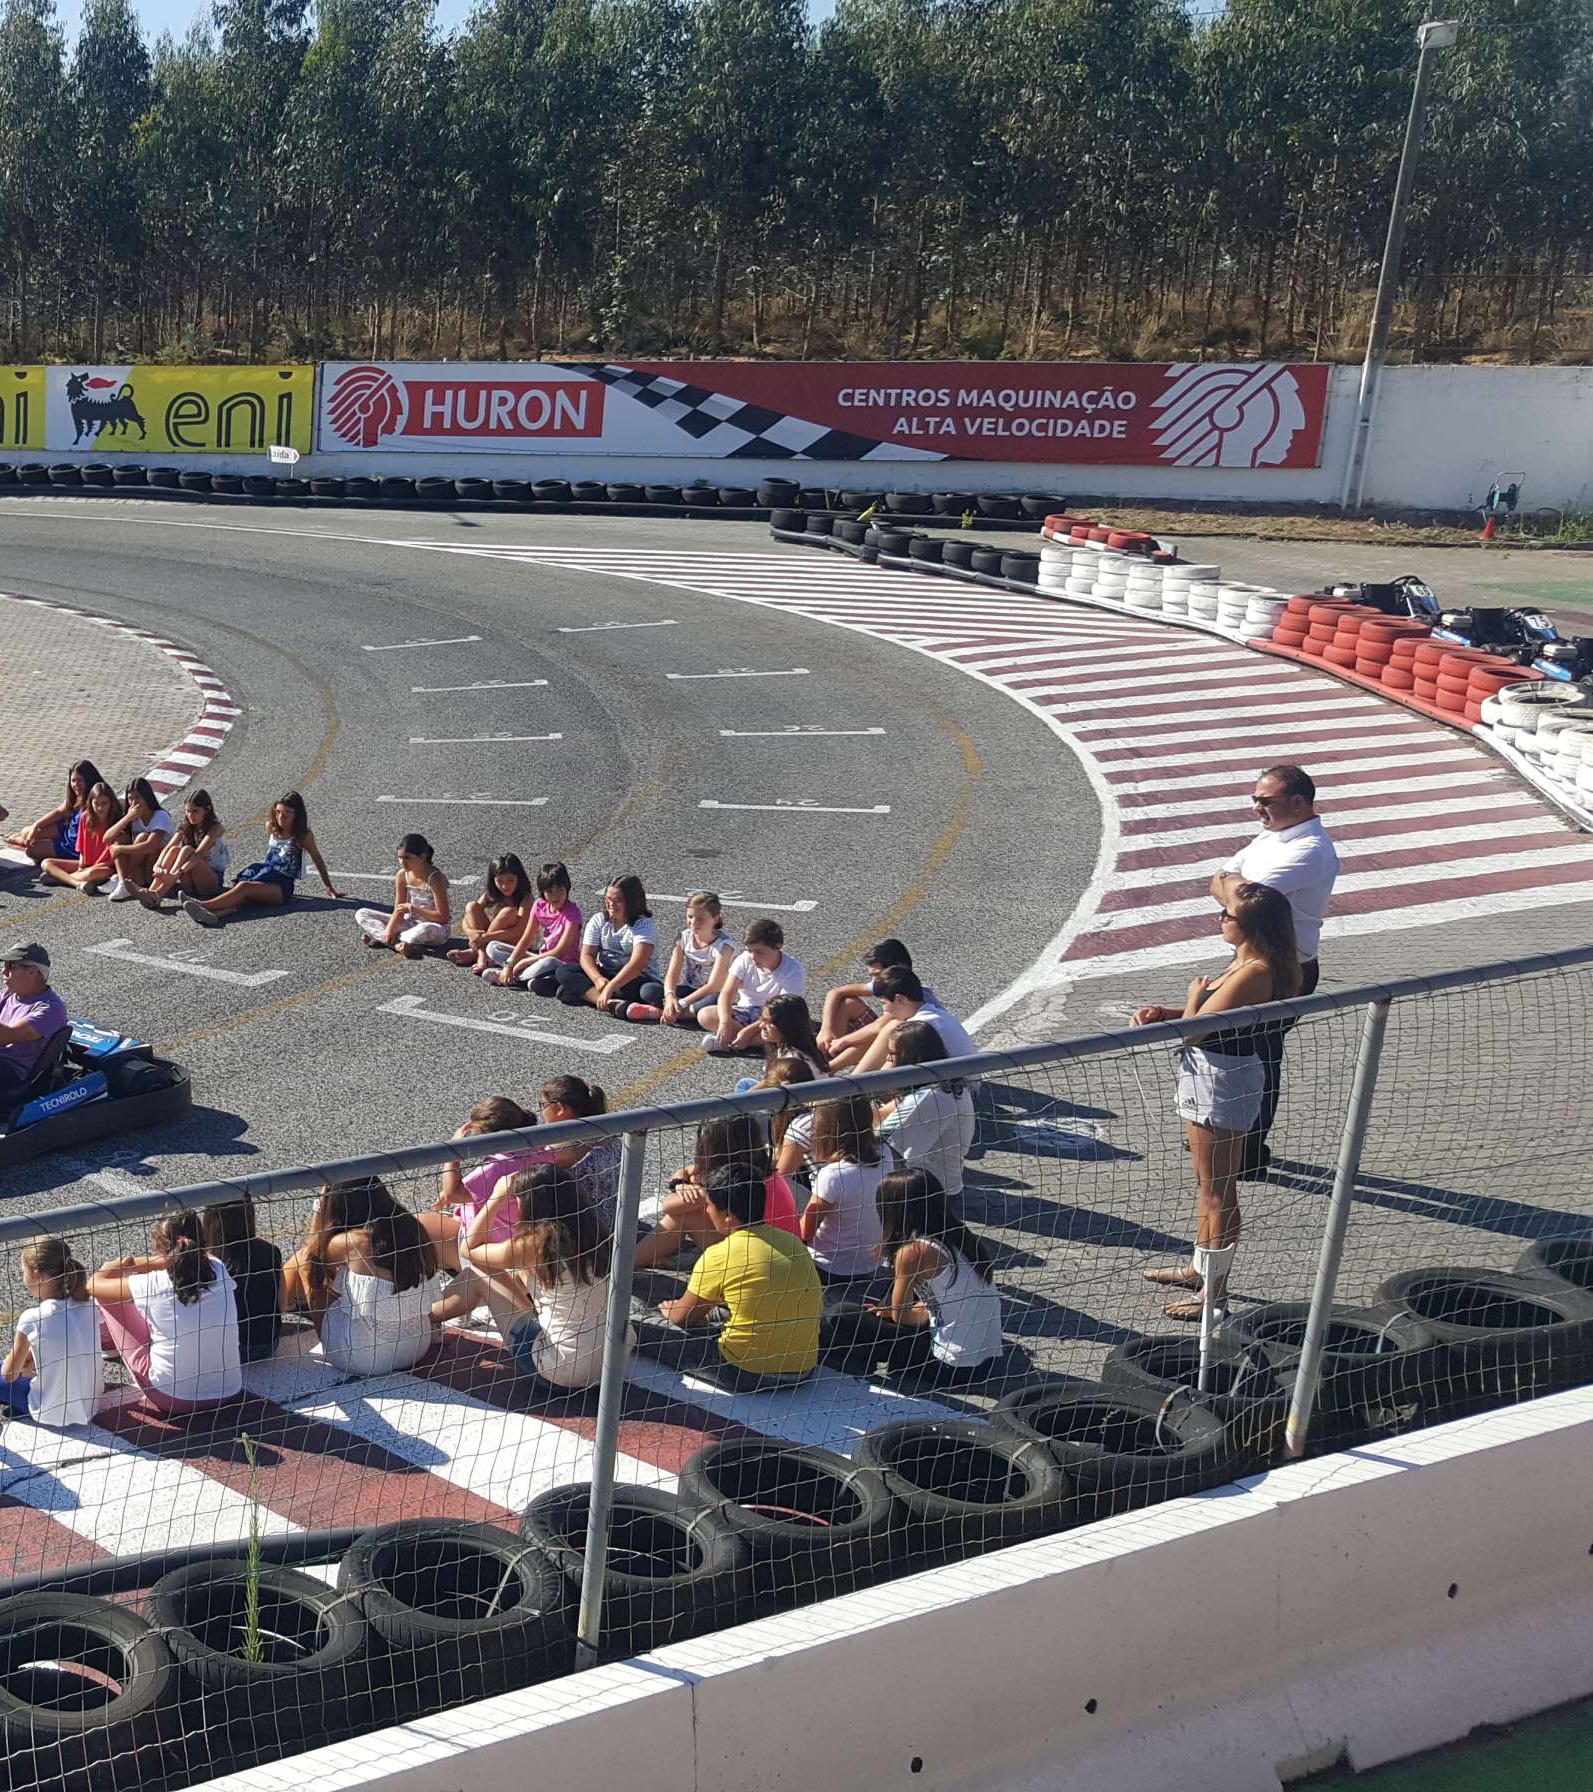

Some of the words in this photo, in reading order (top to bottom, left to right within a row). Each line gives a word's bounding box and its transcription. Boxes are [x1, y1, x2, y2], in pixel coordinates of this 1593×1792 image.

[165, 371, 293, 449] eni
[422, 388, 588, 431] HURON
[837, 388, 950, 407] CENTROS
[957, 386, 1137, 413] MAQUINAÇÃO
[892, 417, 957, 436] ALTA
[964, 417, 1128, 438] VELOCIDADE
[488, 1010, 553, 1026] 20
[39, 1086, 88, 1112] TECNIROLO
